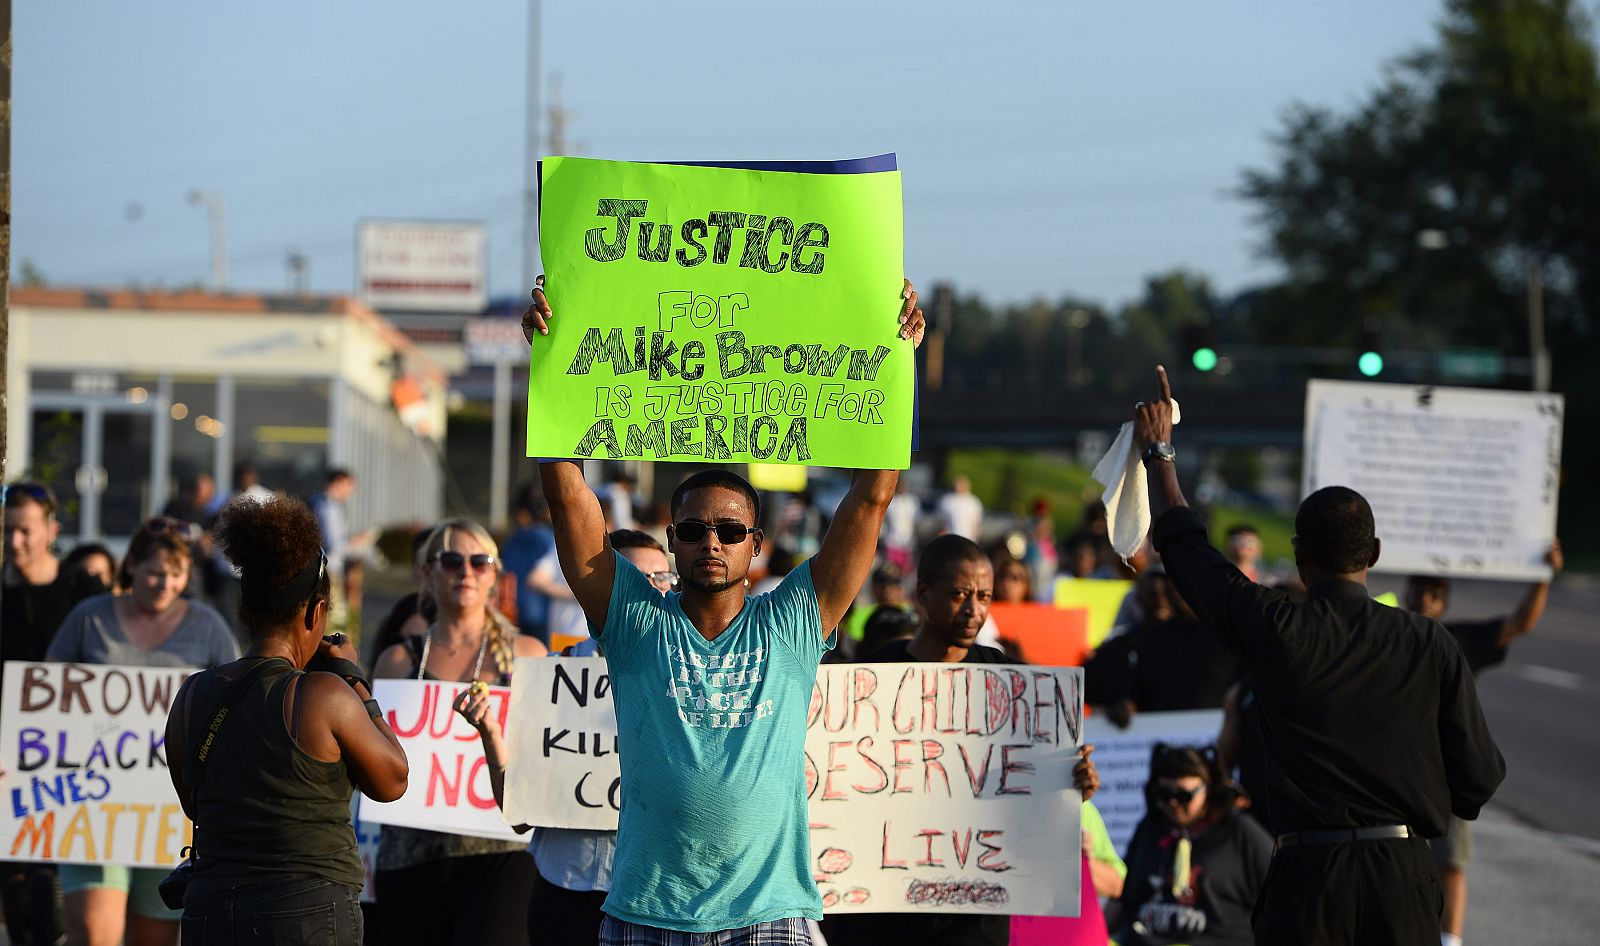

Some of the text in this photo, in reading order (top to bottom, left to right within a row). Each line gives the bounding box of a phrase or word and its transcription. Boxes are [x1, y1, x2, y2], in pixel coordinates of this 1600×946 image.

[566, 326, 706, 380] Mike
[595, 384, 633, 419] IS
[814, 383, 886, 425] FOR
[573, 415, 812, 461] AMERICA
[666, 645, 766, 670] VARIETY
[677, 665, 762, 688] IS THE
[20, 666, 191, 715] BROW
[892, 666, 1082, 748] CHILDREN
[17, 727, 168, 772] BLACK
[198, 731, 216, 763] Nikon
[543, 726, 620, 758] KIL
[12, 769, 110, 818] LIVES
[10, 802, 194, 865] MATTE
[880, 819, 1014, 873] LIVE
